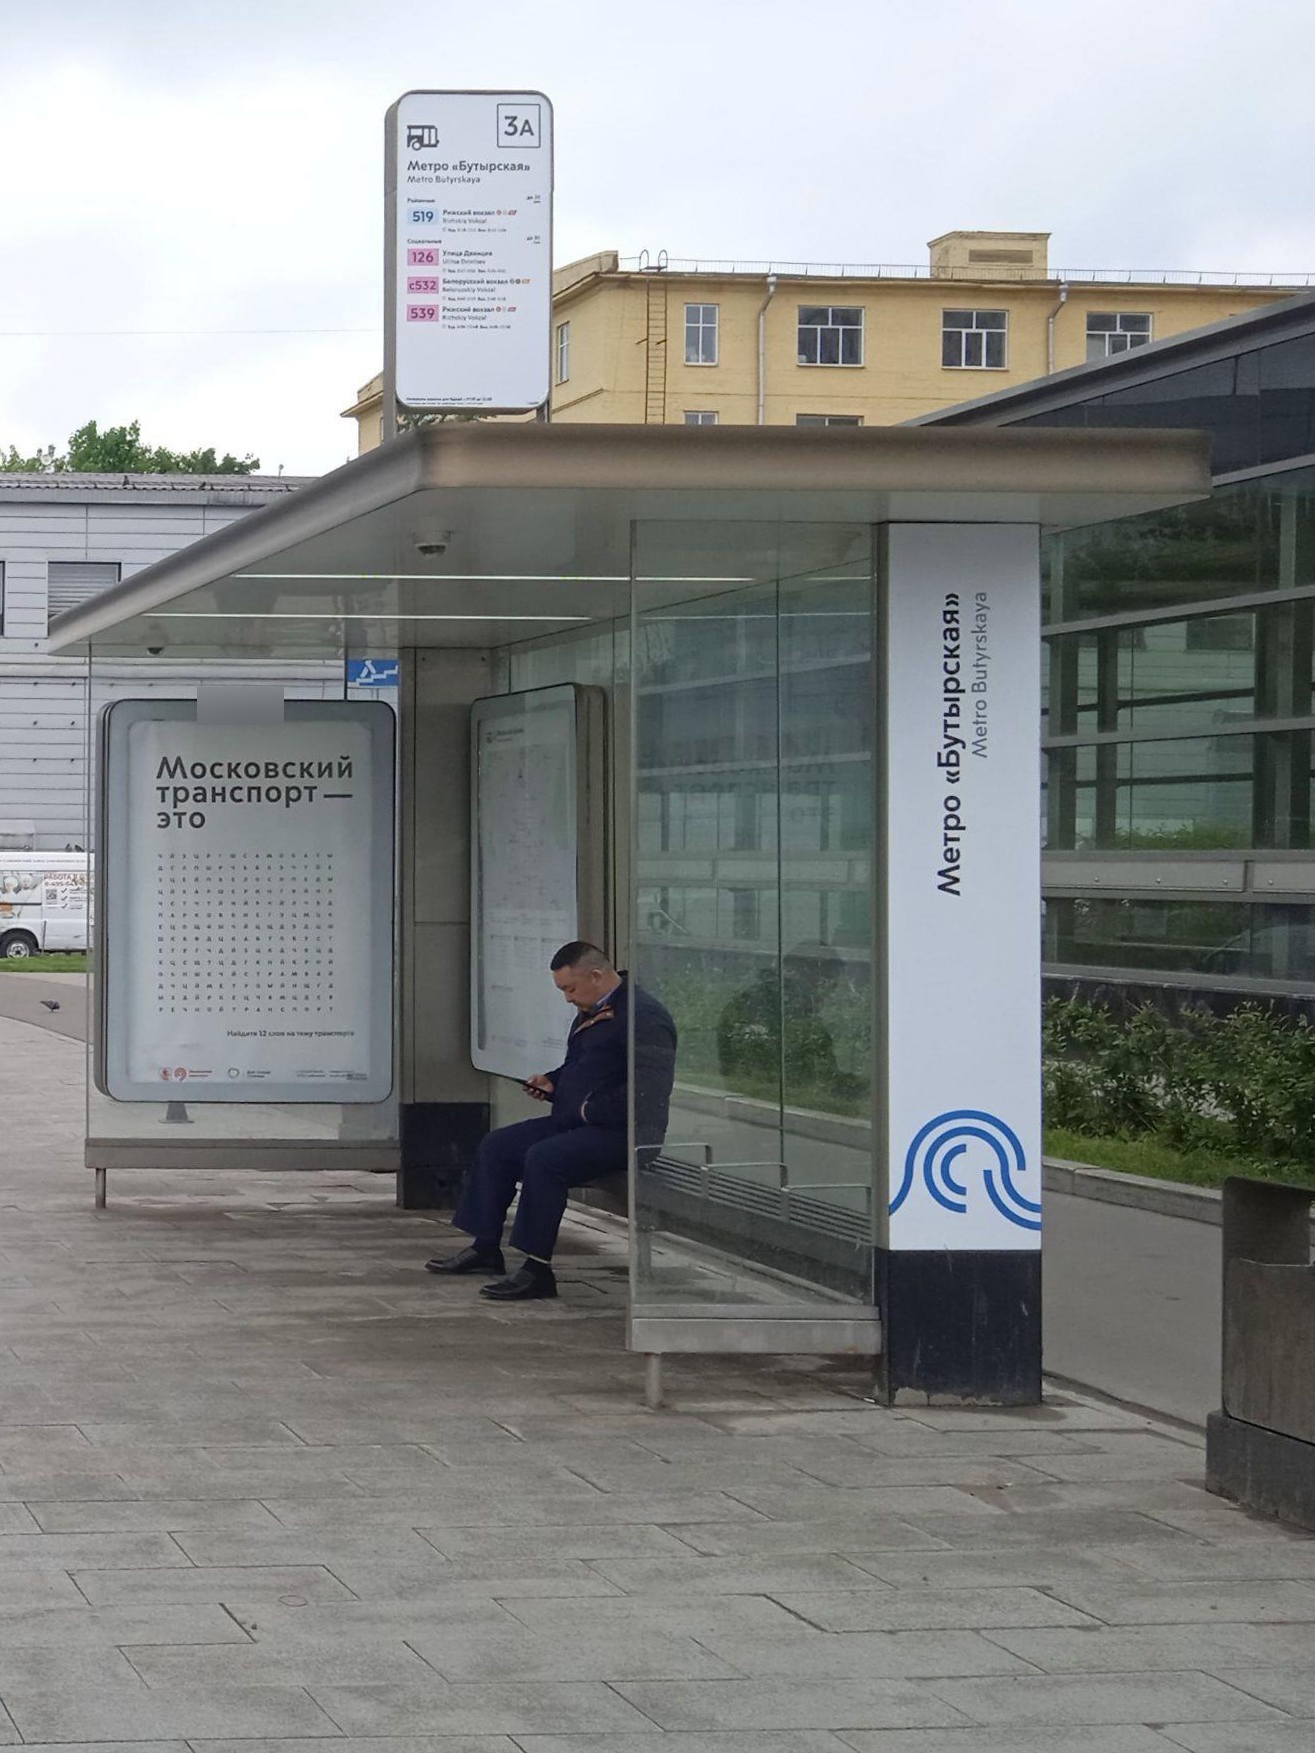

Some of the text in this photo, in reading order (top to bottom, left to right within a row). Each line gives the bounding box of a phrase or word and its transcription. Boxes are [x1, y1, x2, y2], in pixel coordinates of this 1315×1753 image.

[504, 116, 534, 137] 3А
[407, 160, 531, 174] Метро «Бутырская»
[407, 176, 481, 185] Metro Butyrskaya
[412, 211, 434, 222] 519
[412, 251, 434, 263] 126
[410, 308, 435, 319] 539
[971, 591, 992, 758] Metro Butyrskaya
[937, 593, 966, 896] Метро «Бутырская»
[156, 755, 353, 779] Московский
[156, 785, 318, 808] транспорт
[156, 811, 206, 829] это
